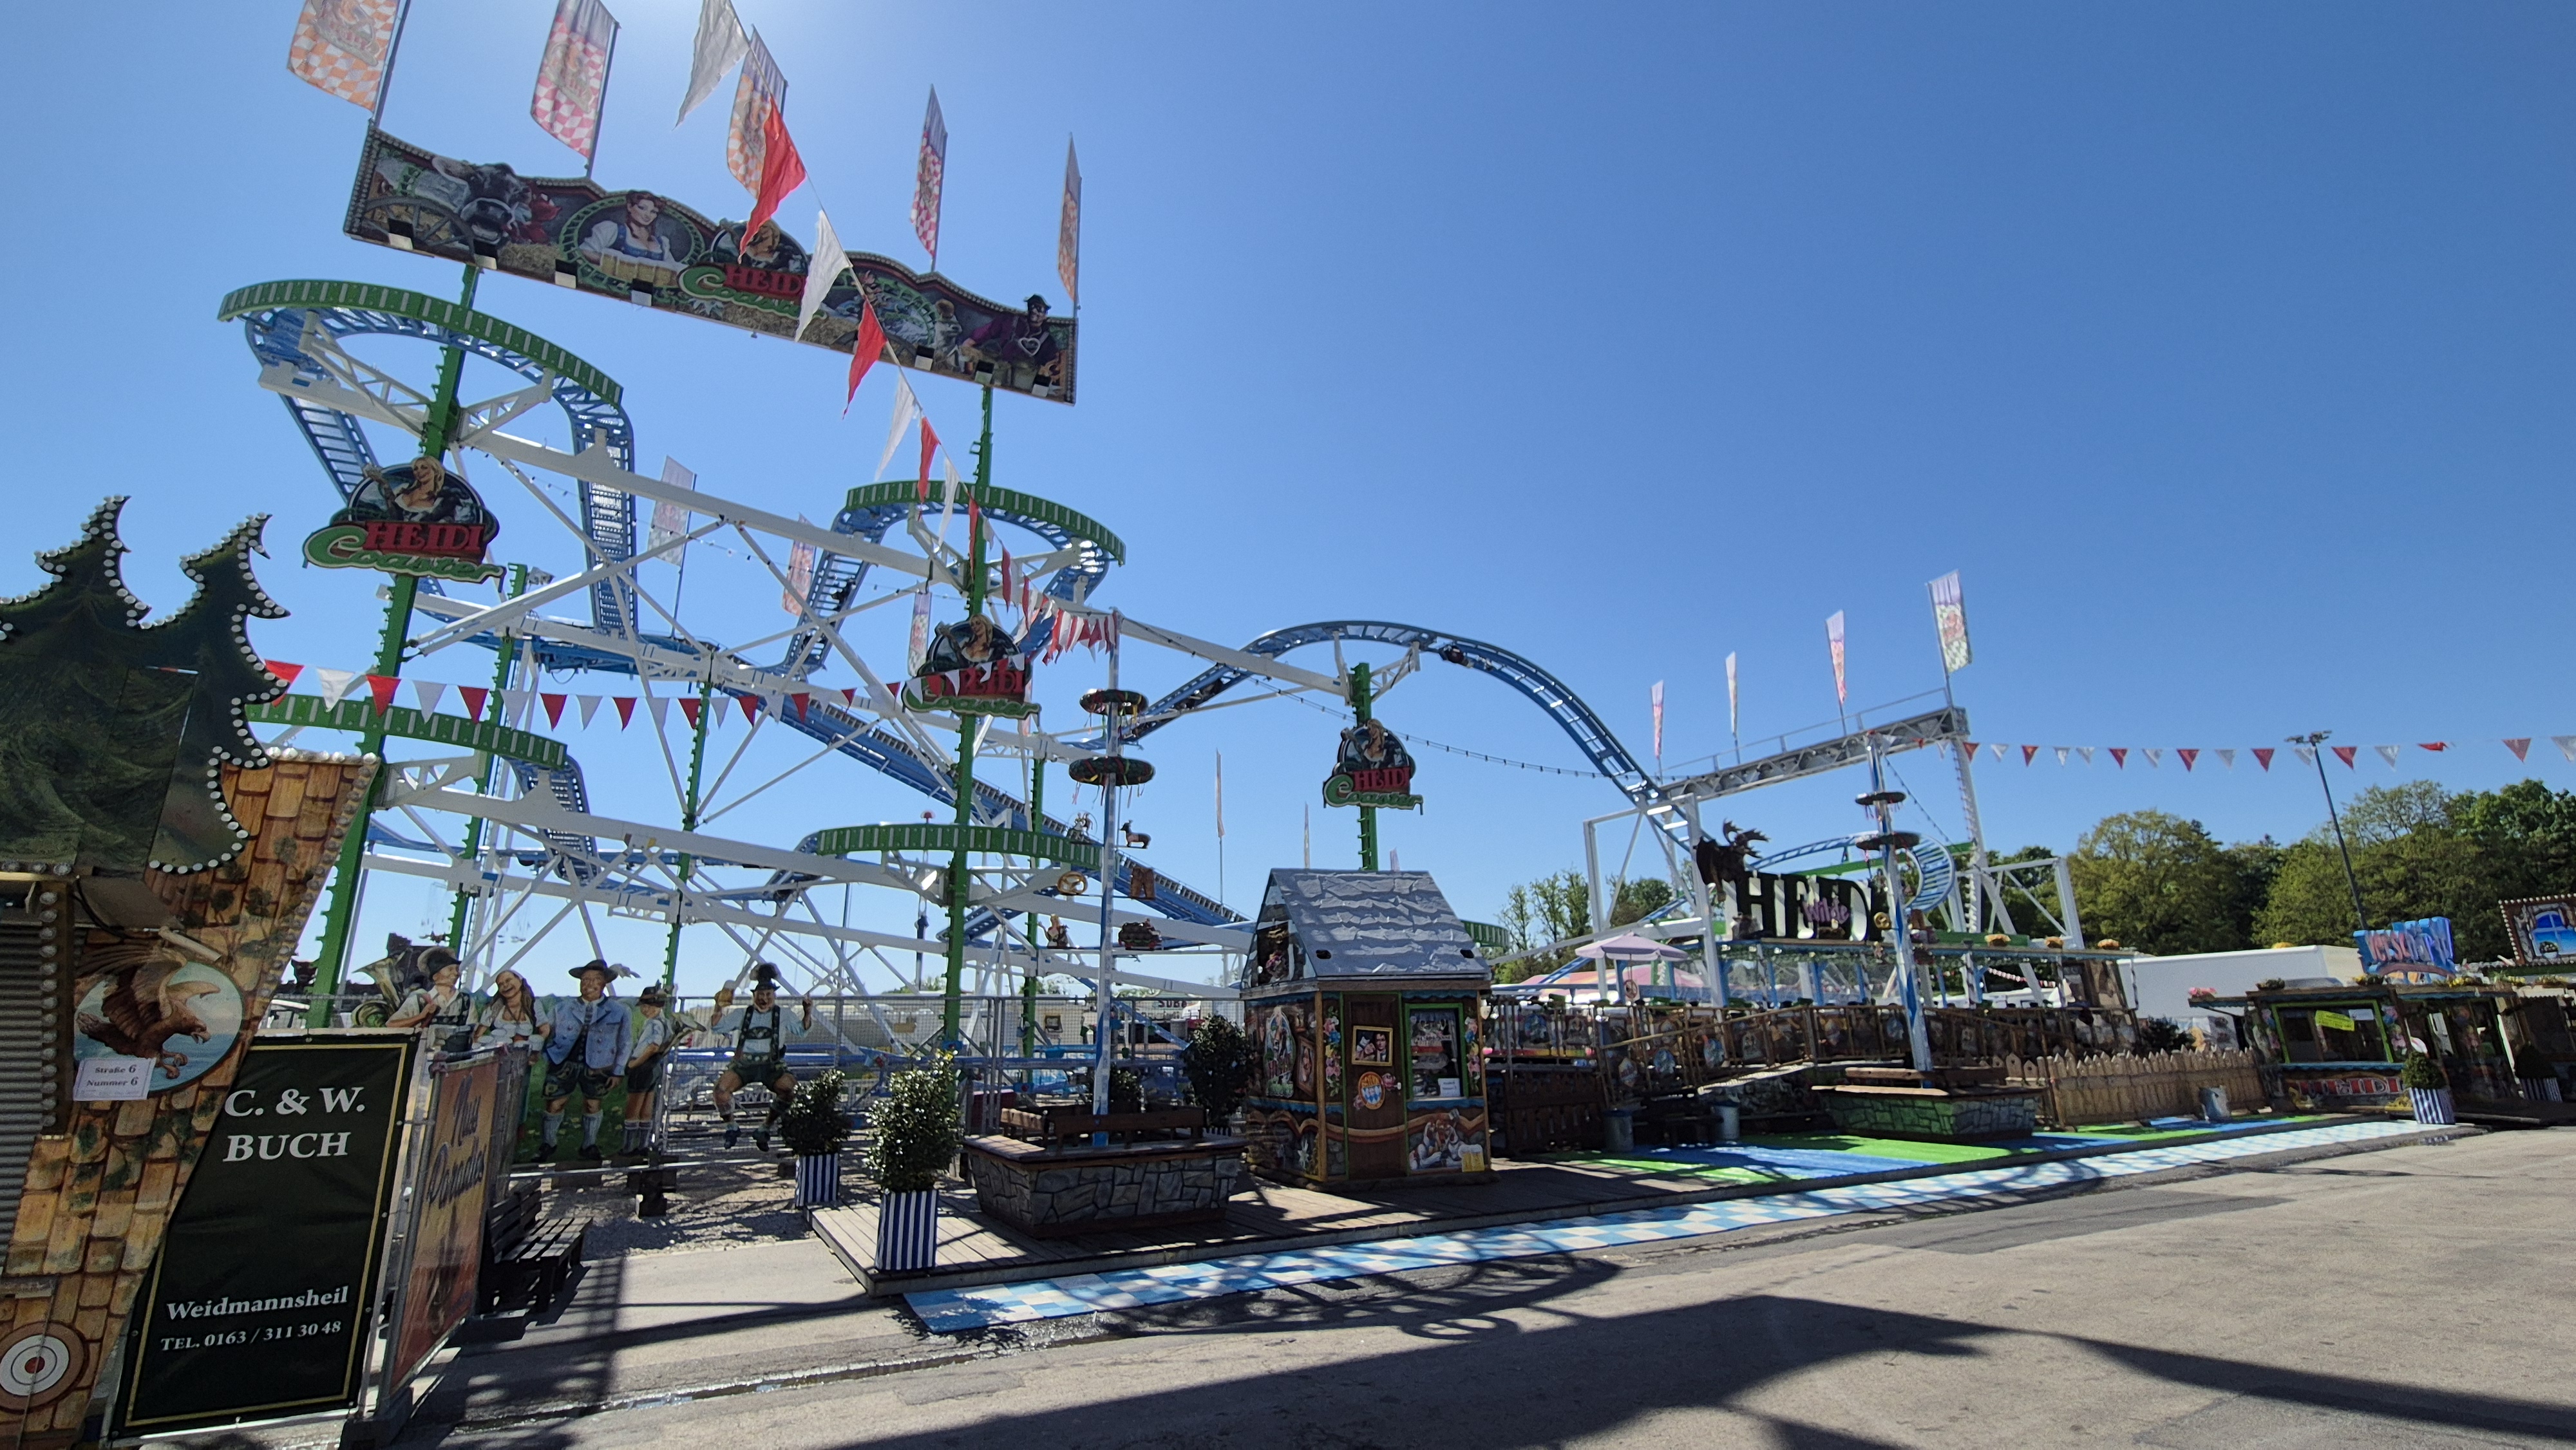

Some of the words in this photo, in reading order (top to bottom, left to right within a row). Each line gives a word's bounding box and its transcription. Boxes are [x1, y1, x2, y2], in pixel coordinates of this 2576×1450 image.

[723, 263, 808, 301] HEID
[363, 520, 486, 554] HEIDI
[303, 525, 505, 583] Coaster
[1353, 767, 1410, 792] HEIDI
[129, 1064, 137, 1073] 6
[130, 1077, 138, 1086] 6
[224, 1089, 264, 1117] C.
[275, 1088, 310, 1116] &
[319, 1086, 365, 1113] W.
[222, 1131, 352, 1162] BUCH
[166, 1285, 349, 1320] Weidmannsheil
[161, 1337, 200, 1351] TEL.
[204, 1331, 247, 1347] 0163
[263, 1326, 293, 1341] 311
[298, 1323, 319, 1337] 30
[321, 1321, 342, 1334] 48
